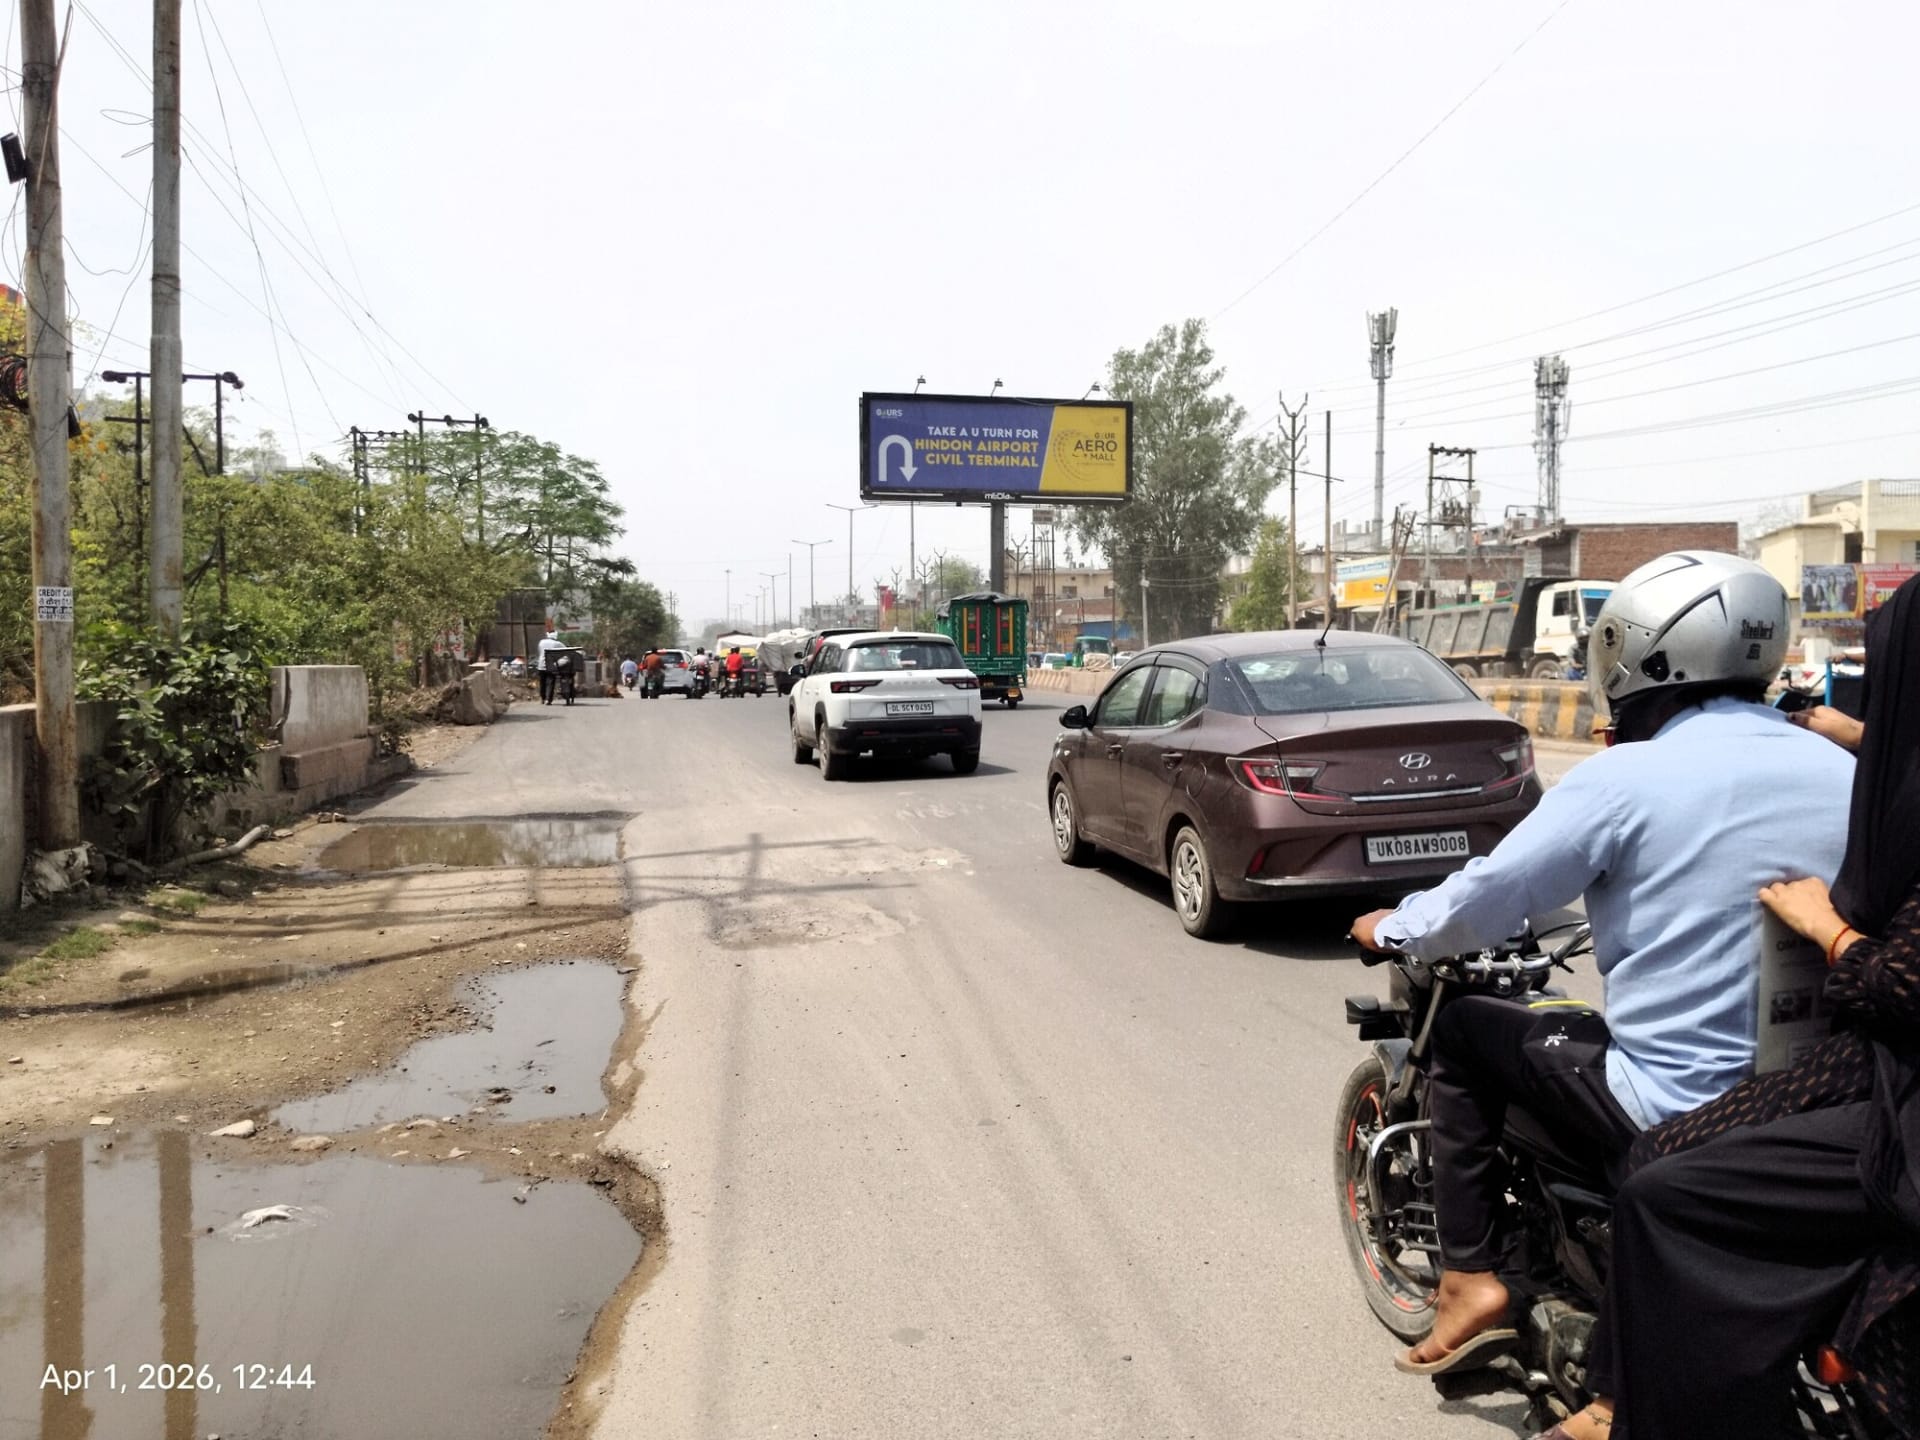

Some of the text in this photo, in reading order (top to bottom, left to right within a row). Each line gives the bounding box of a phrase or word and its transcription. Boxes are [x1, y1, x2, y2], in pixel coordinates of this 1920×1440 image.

[928, 426, 1039, 439] TAKE A U TURN FOR
[915, 439, 1039, 453] HINDON AIRPORT
[1074, 439, 1118, 452] AERO
[925, 453, 1039, 467] CIVIL TERMINAL
[1090, 453, 1116, 461] MALL
[39, 588, 61, 597] CREDIT
[1383, 773, 1456, 785] AURA
[1376, 836, 1467, 857] UK08AW9008
